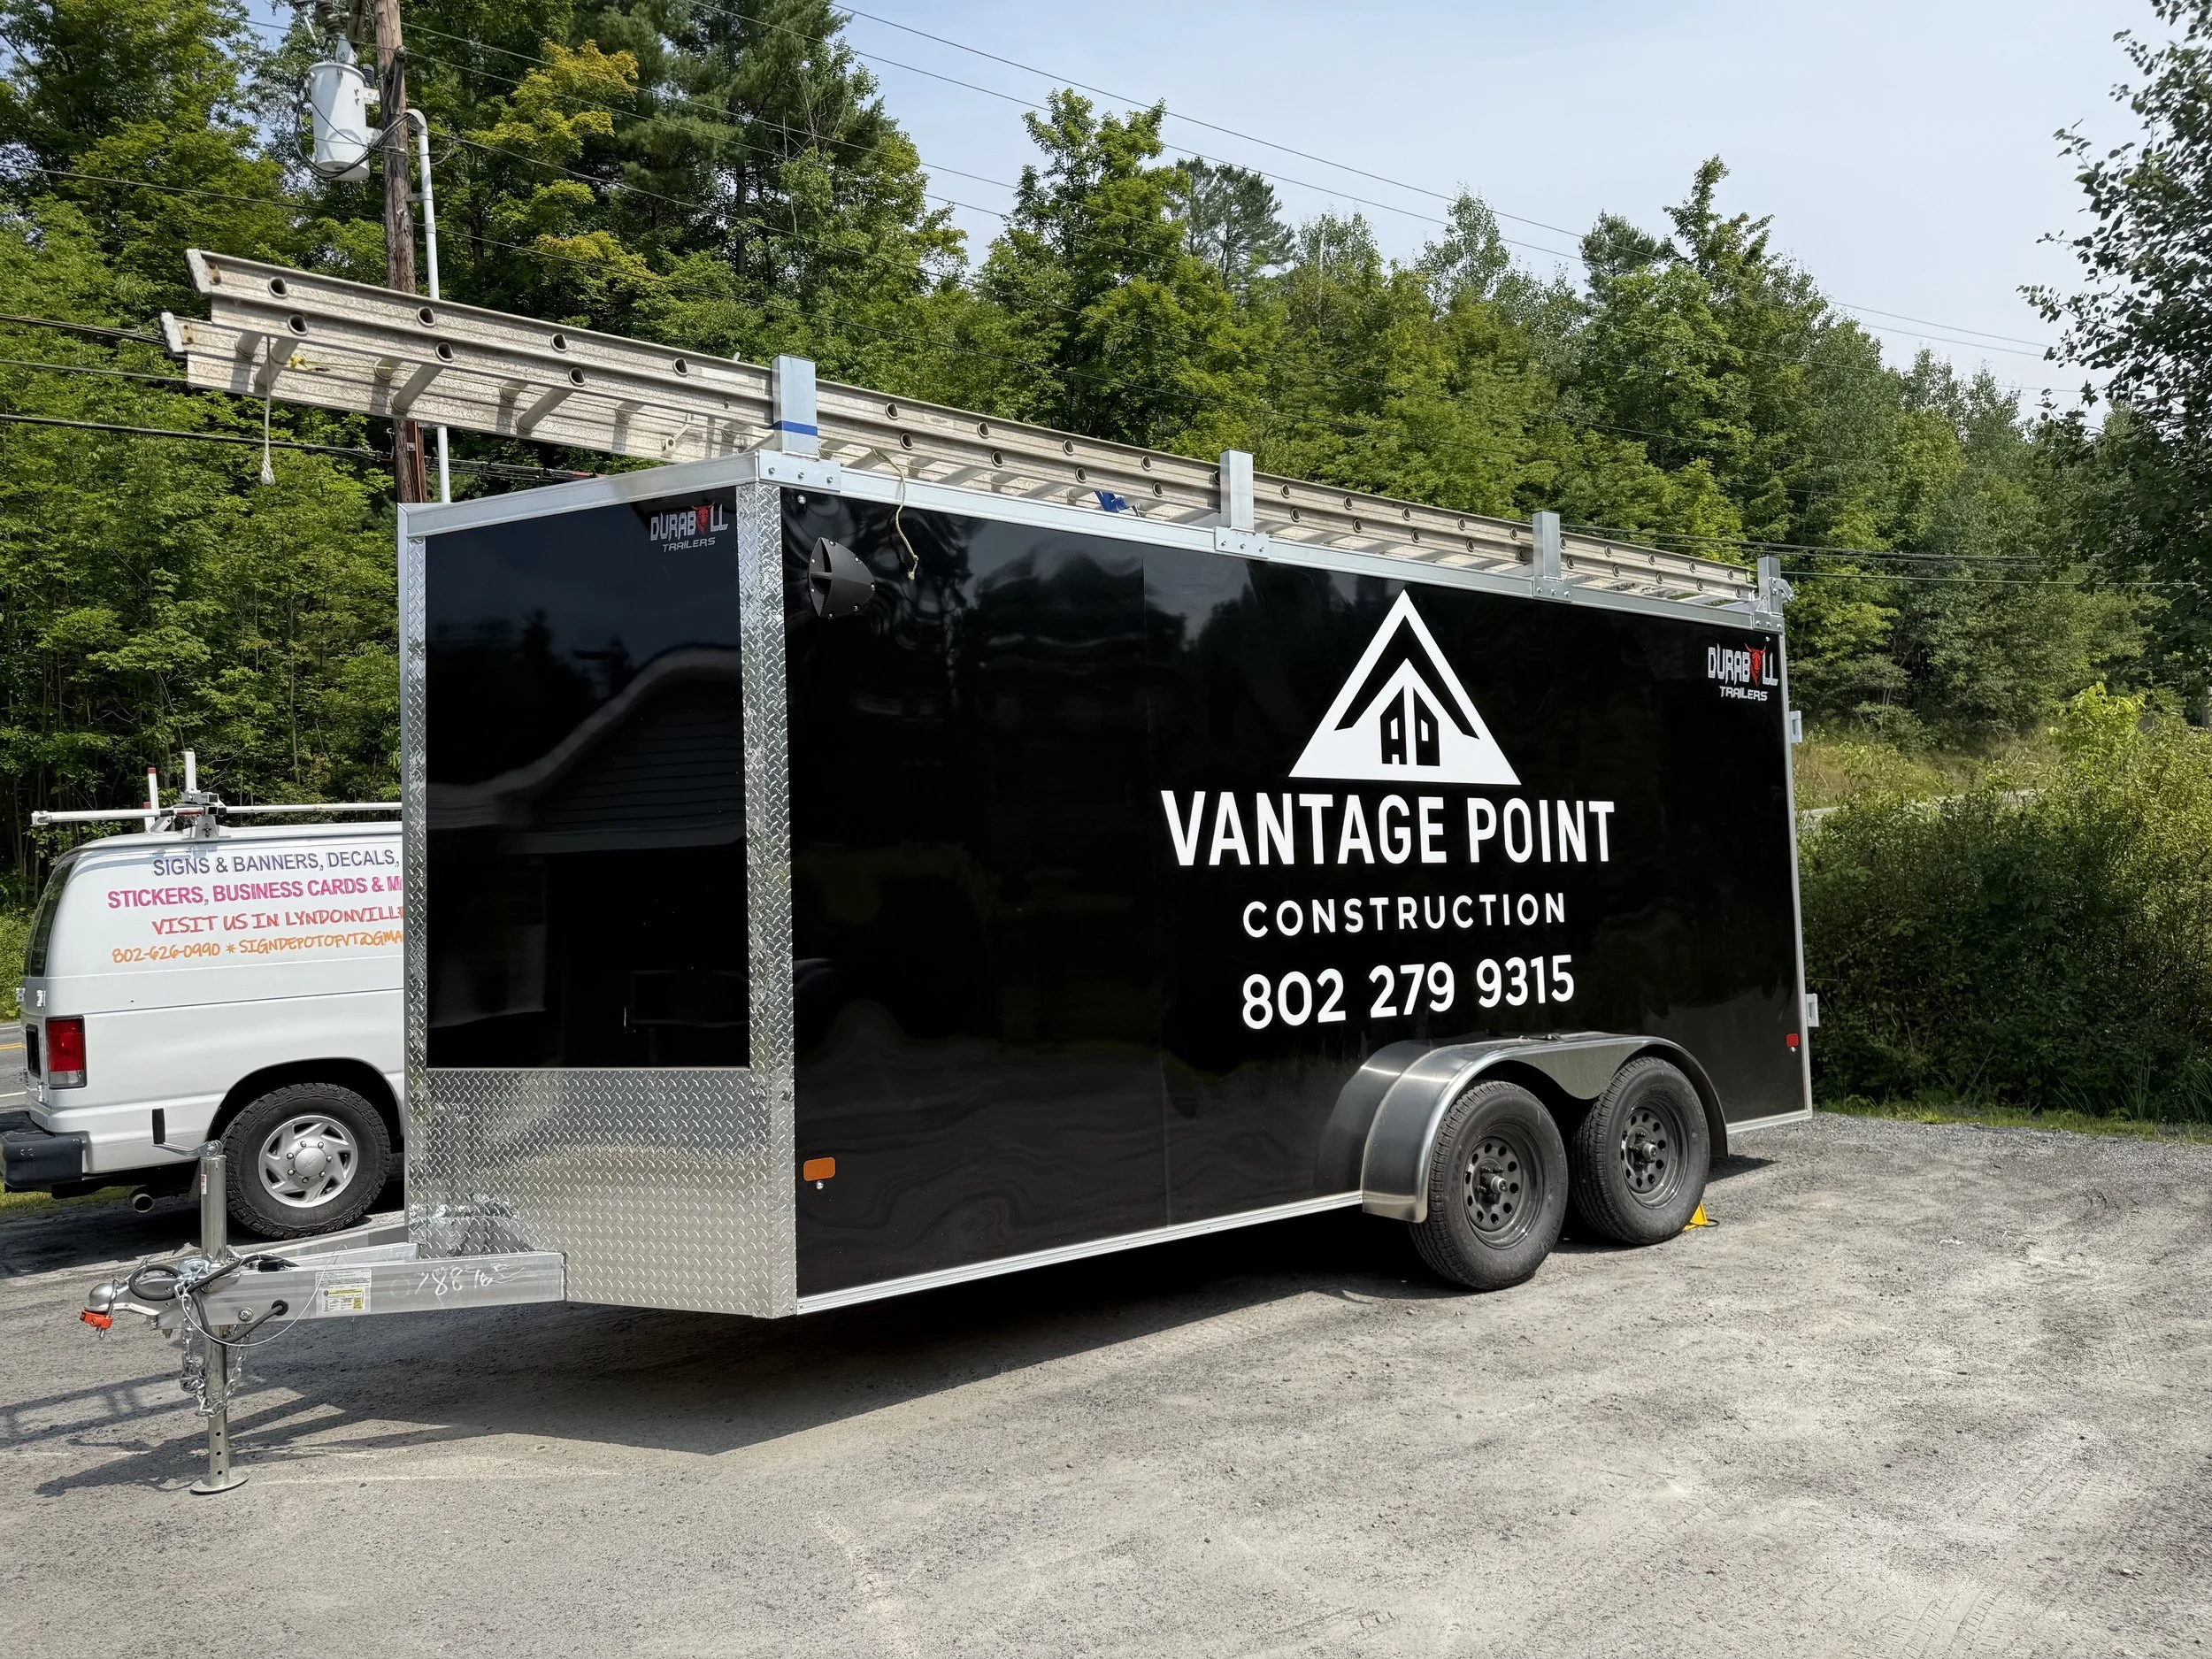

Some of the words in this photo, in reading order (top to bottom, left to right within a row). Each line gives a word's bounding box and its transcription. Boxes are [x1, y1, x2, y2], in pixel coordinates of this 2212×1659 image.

[663, 536, 716, 552] TRAILERS
[1719, 686, 1768, 702] TRAILERS
[1160, 789, 1448, 867] VANTAGE
[1466, 796, 1616, 864] POINT
[153, 856, 210, 876] SIGNS
[216, 856, 228, 873] &
[233, 852, 324, 872] BANNERS,
[326, 849, 400, 869] DECALS,
[107, 886, 209, 909] STICKERS,
[212, 880, 304, 902] BUSINESS
[307, 876, 368, 896] CARDS
[372, 876, 385, 893] &
[387, 875, 403, 892] M
[151, 915, 219, 935] VISIT
[223, 912, 249, 932] US
[251, 912, 280, 929] IN
[1242, 892, 1566, 938] CONSTRUCTION
[111, 942, 221, 964] 802-626-0990
[238, 929, 403, 955] SIGNDEPOTOFVT@GMA
[1241, 967, 1347, 1030] 802
[1368, 961, 1455, 1019] 279
[1476, 954, 1575, 1009] 9315
